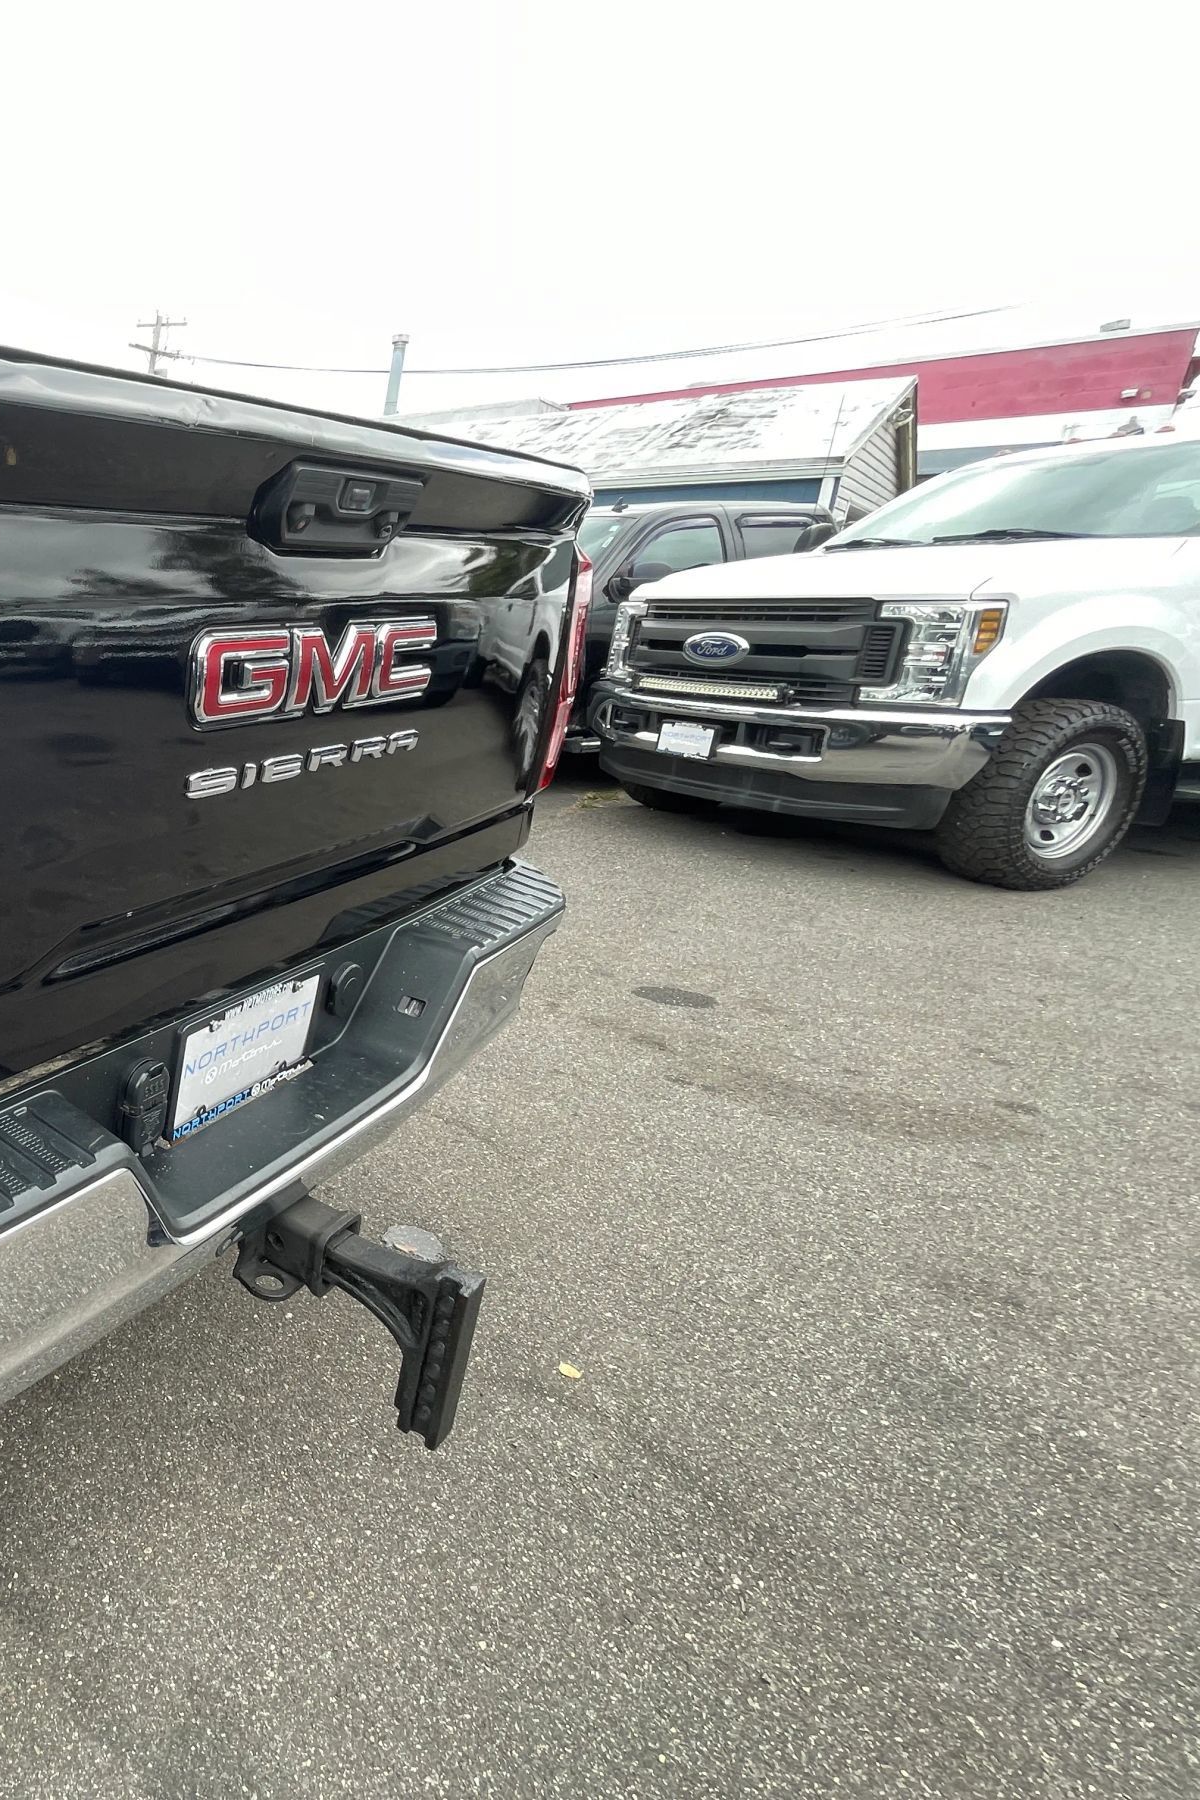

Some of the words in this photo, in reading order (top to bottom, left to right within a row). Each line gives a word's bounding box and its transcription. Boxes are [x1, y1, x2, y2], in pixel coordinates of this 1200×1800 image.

[189, 617, 437, 727] GMC
[696, 639, 728, 656] Ford
[185, 729, 420, 799] SIERRA
[184, 1002, 311, 1079] NORTHPORT
[173, 1089, 250, 1141] NORTHPORT
